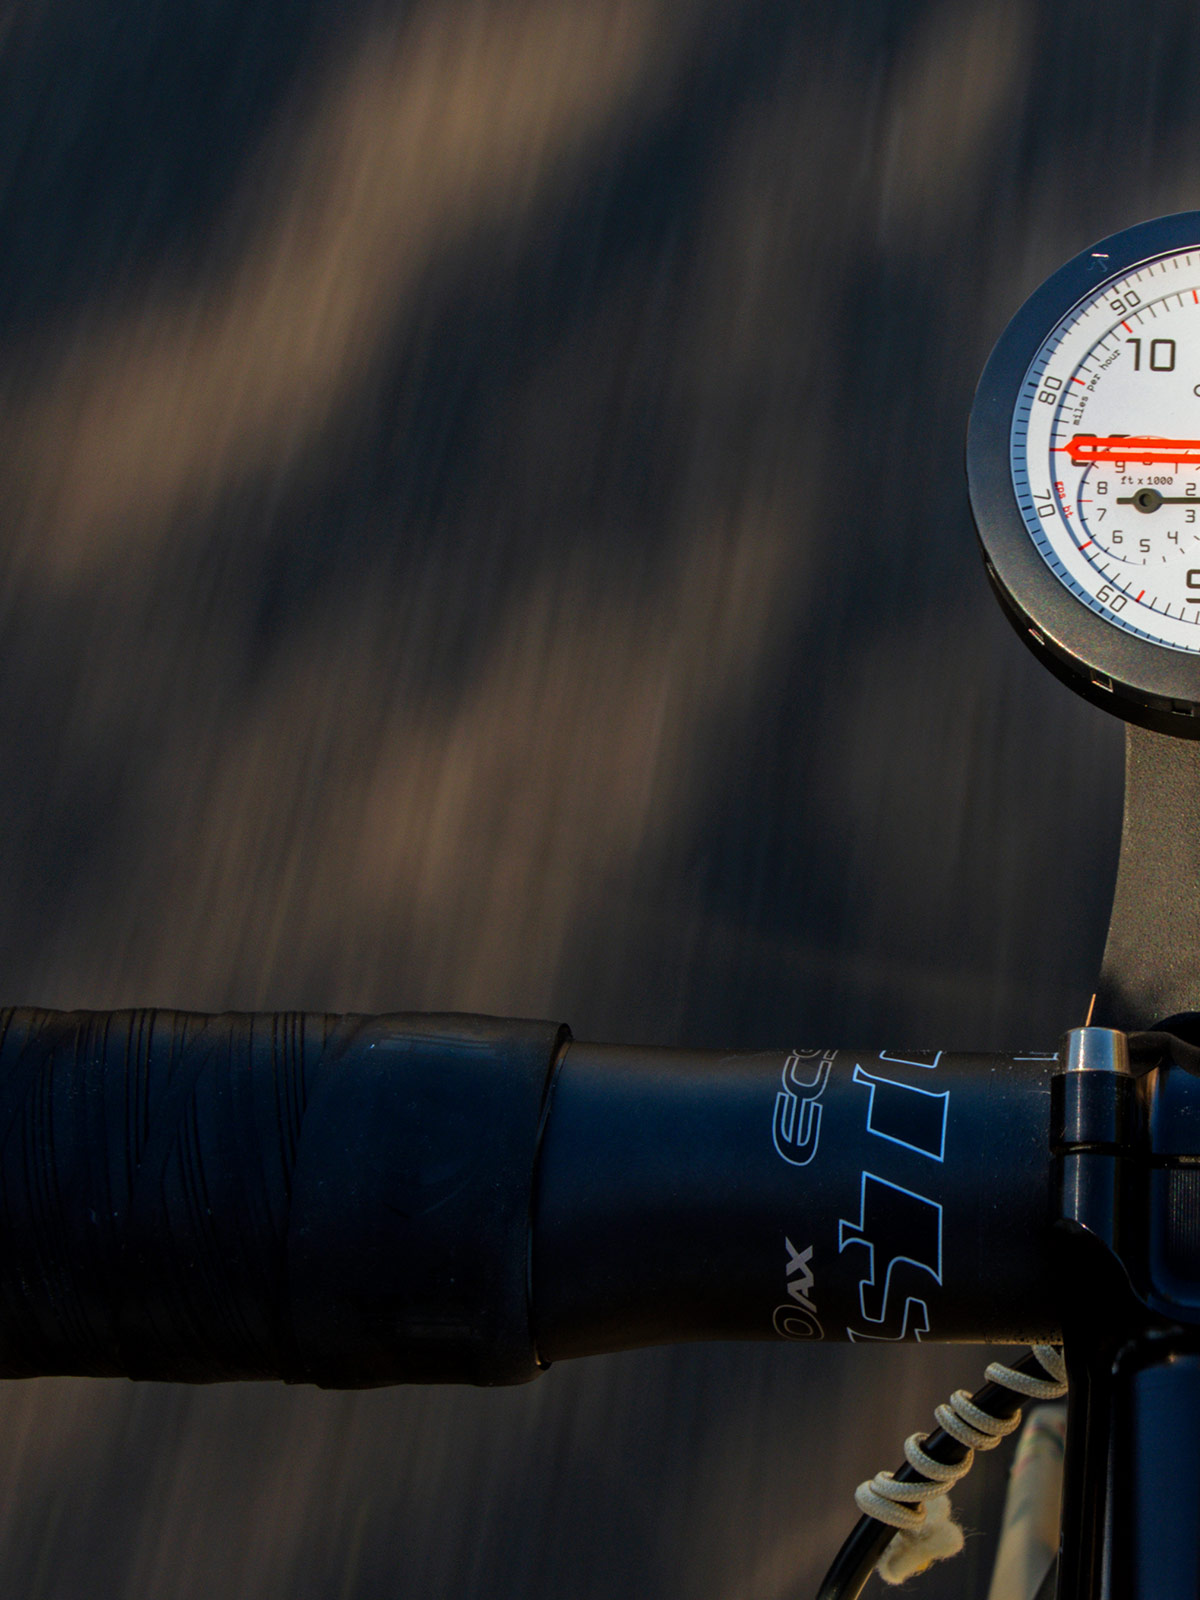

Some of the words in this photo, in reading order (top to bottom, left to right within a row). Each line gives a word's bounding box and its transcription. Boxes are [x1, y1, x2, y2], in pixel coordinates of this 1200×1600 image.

[1110, 290, 1141, 316] 90
[1125, 338, 1176, 372] 10
[1038, 376, 1063, 405] 80
[1072, 396, 1089, 426] miles
[1086, 374, 1101, 393] per
[1099, 348, 1121, 371] hour
[1097, 481, 1108, 495] 8
[1120, 475, 1134, 486] ft
[1146, 476, 1174, 486] 1000
[1185, 483, 1197, 496] 2
[1033, 488, 1056, 518] 70
[1062, 504, 1074, 519] bt
[1096, 508, 1107, 521] 7
[1185, 509, 1196, 523] 3
[1112, 530, 1123, 544] 6
[1167, 531, 1178, 545] 4
[1139, 538, 1150, 553] 5
[1095, 584, 1128, 613] 60
